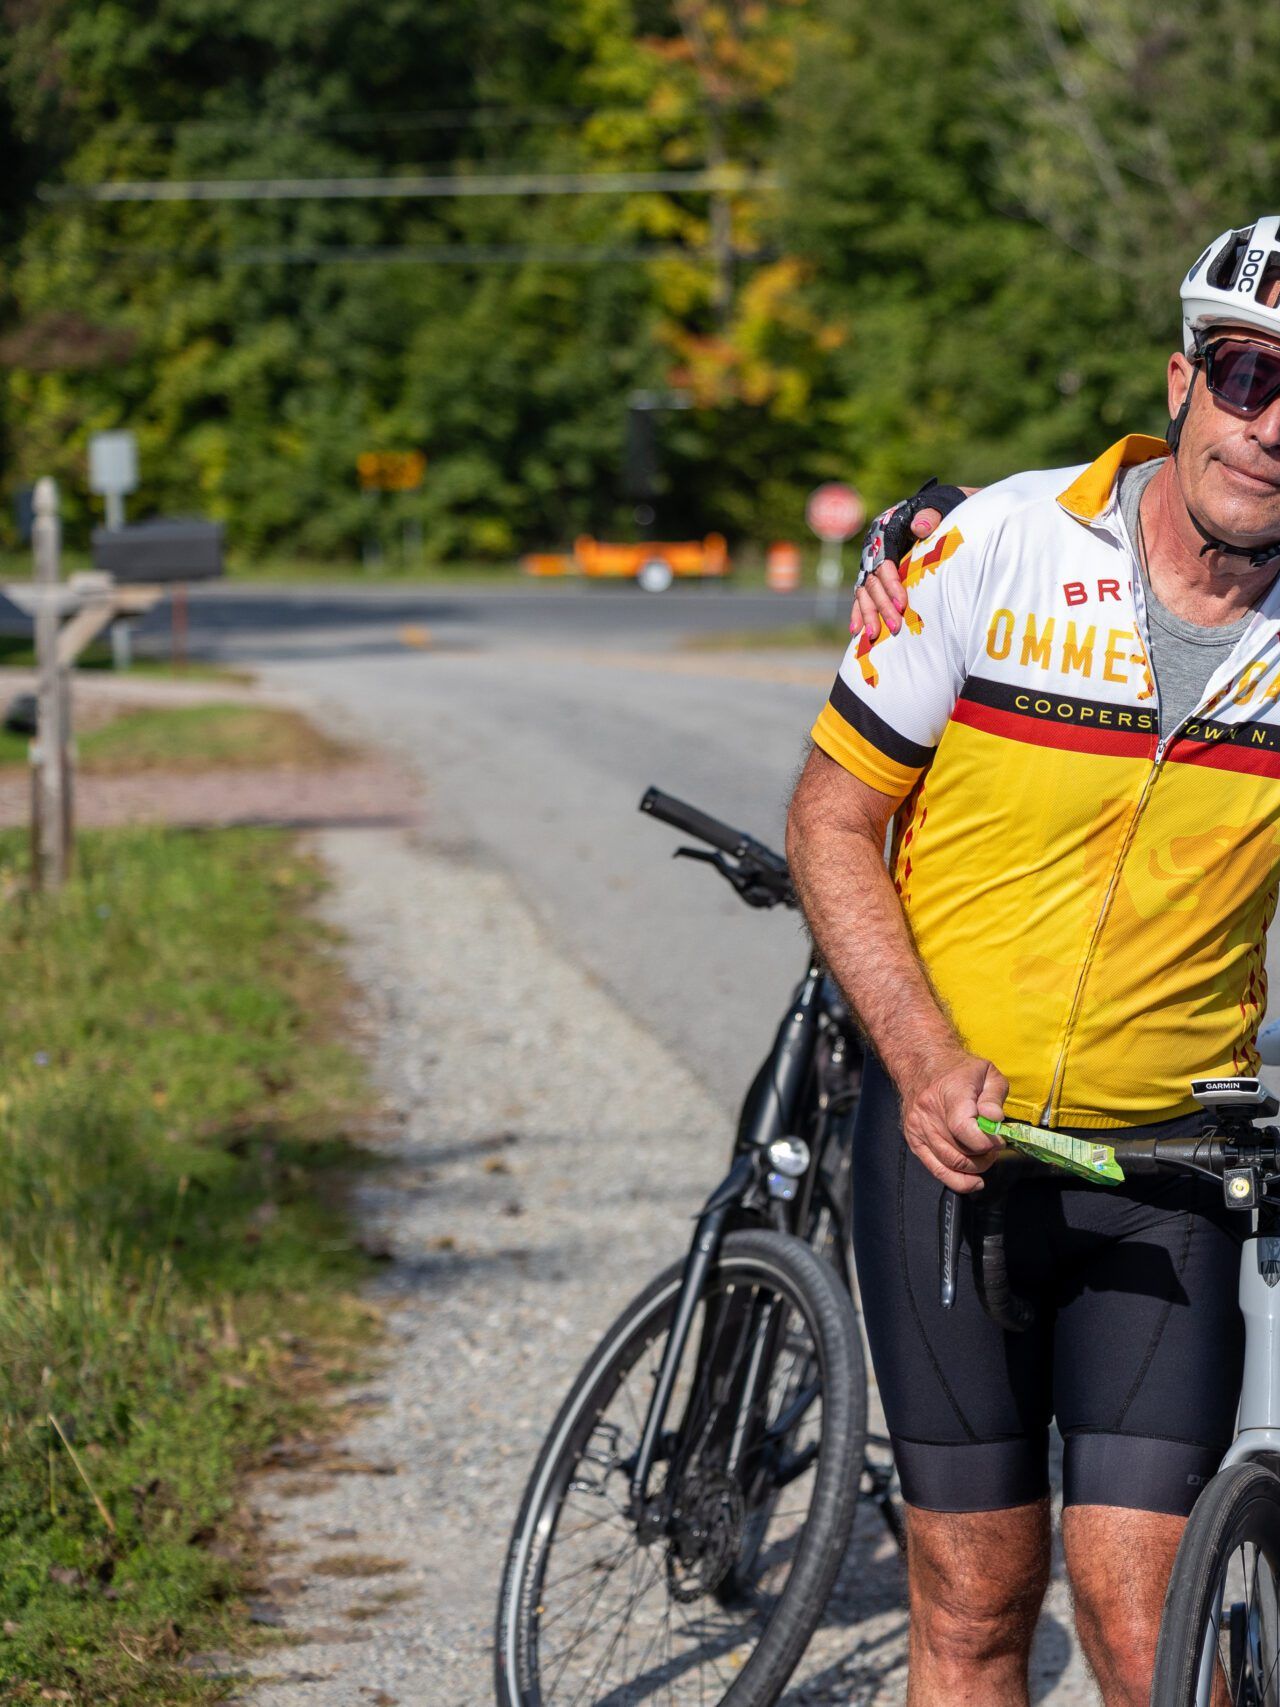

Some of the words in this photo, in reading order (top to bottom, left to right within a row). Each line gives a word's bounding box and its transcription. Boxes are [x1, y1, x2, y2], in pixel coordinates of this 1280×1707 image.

[1063, 579, 1133, 607] BR
[1014, 695, 1159, 729] COOPERS
[1205, 1082, 1240, 1090] GARMIN
